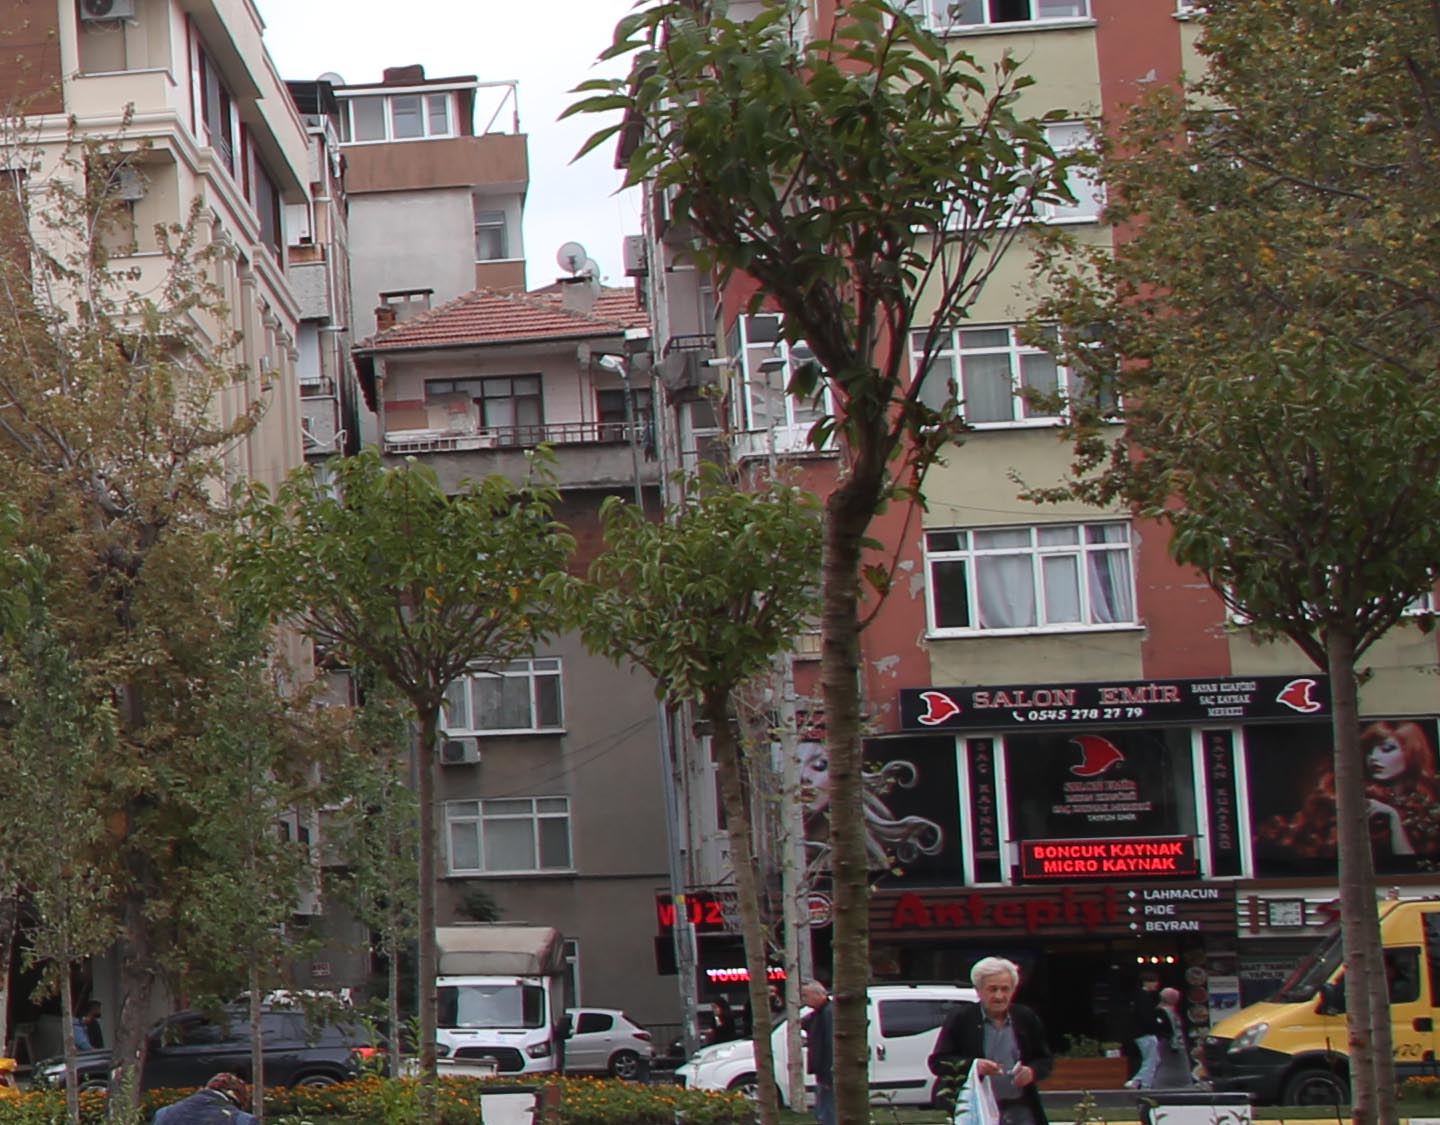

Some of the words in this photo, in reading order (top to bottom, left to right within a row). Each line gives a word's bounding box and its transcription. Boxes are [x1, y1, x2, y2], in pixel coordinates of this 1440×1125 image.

[972, 689, 1077, 709] SALON
[1098, 682, 1180, 706] EMİR
[1028, 708, 1067, 721] 0545
[1071, 708, 1098, 720] 278
[1102, 708, 1120, 719] 27
[1125, 707, 1143, 718] 79
[1033, 845, 1106, 860] BONCUK
[1110, 843, 1184, 857] KAYNAK
[1043, 859, 1098, 873] MICRO
[1103, 857, 1176, 871] KAYNAK
[1143, 888, 1219, 900] LAHMACUN
[1146, 920, 1200, 932] BEYRAN
